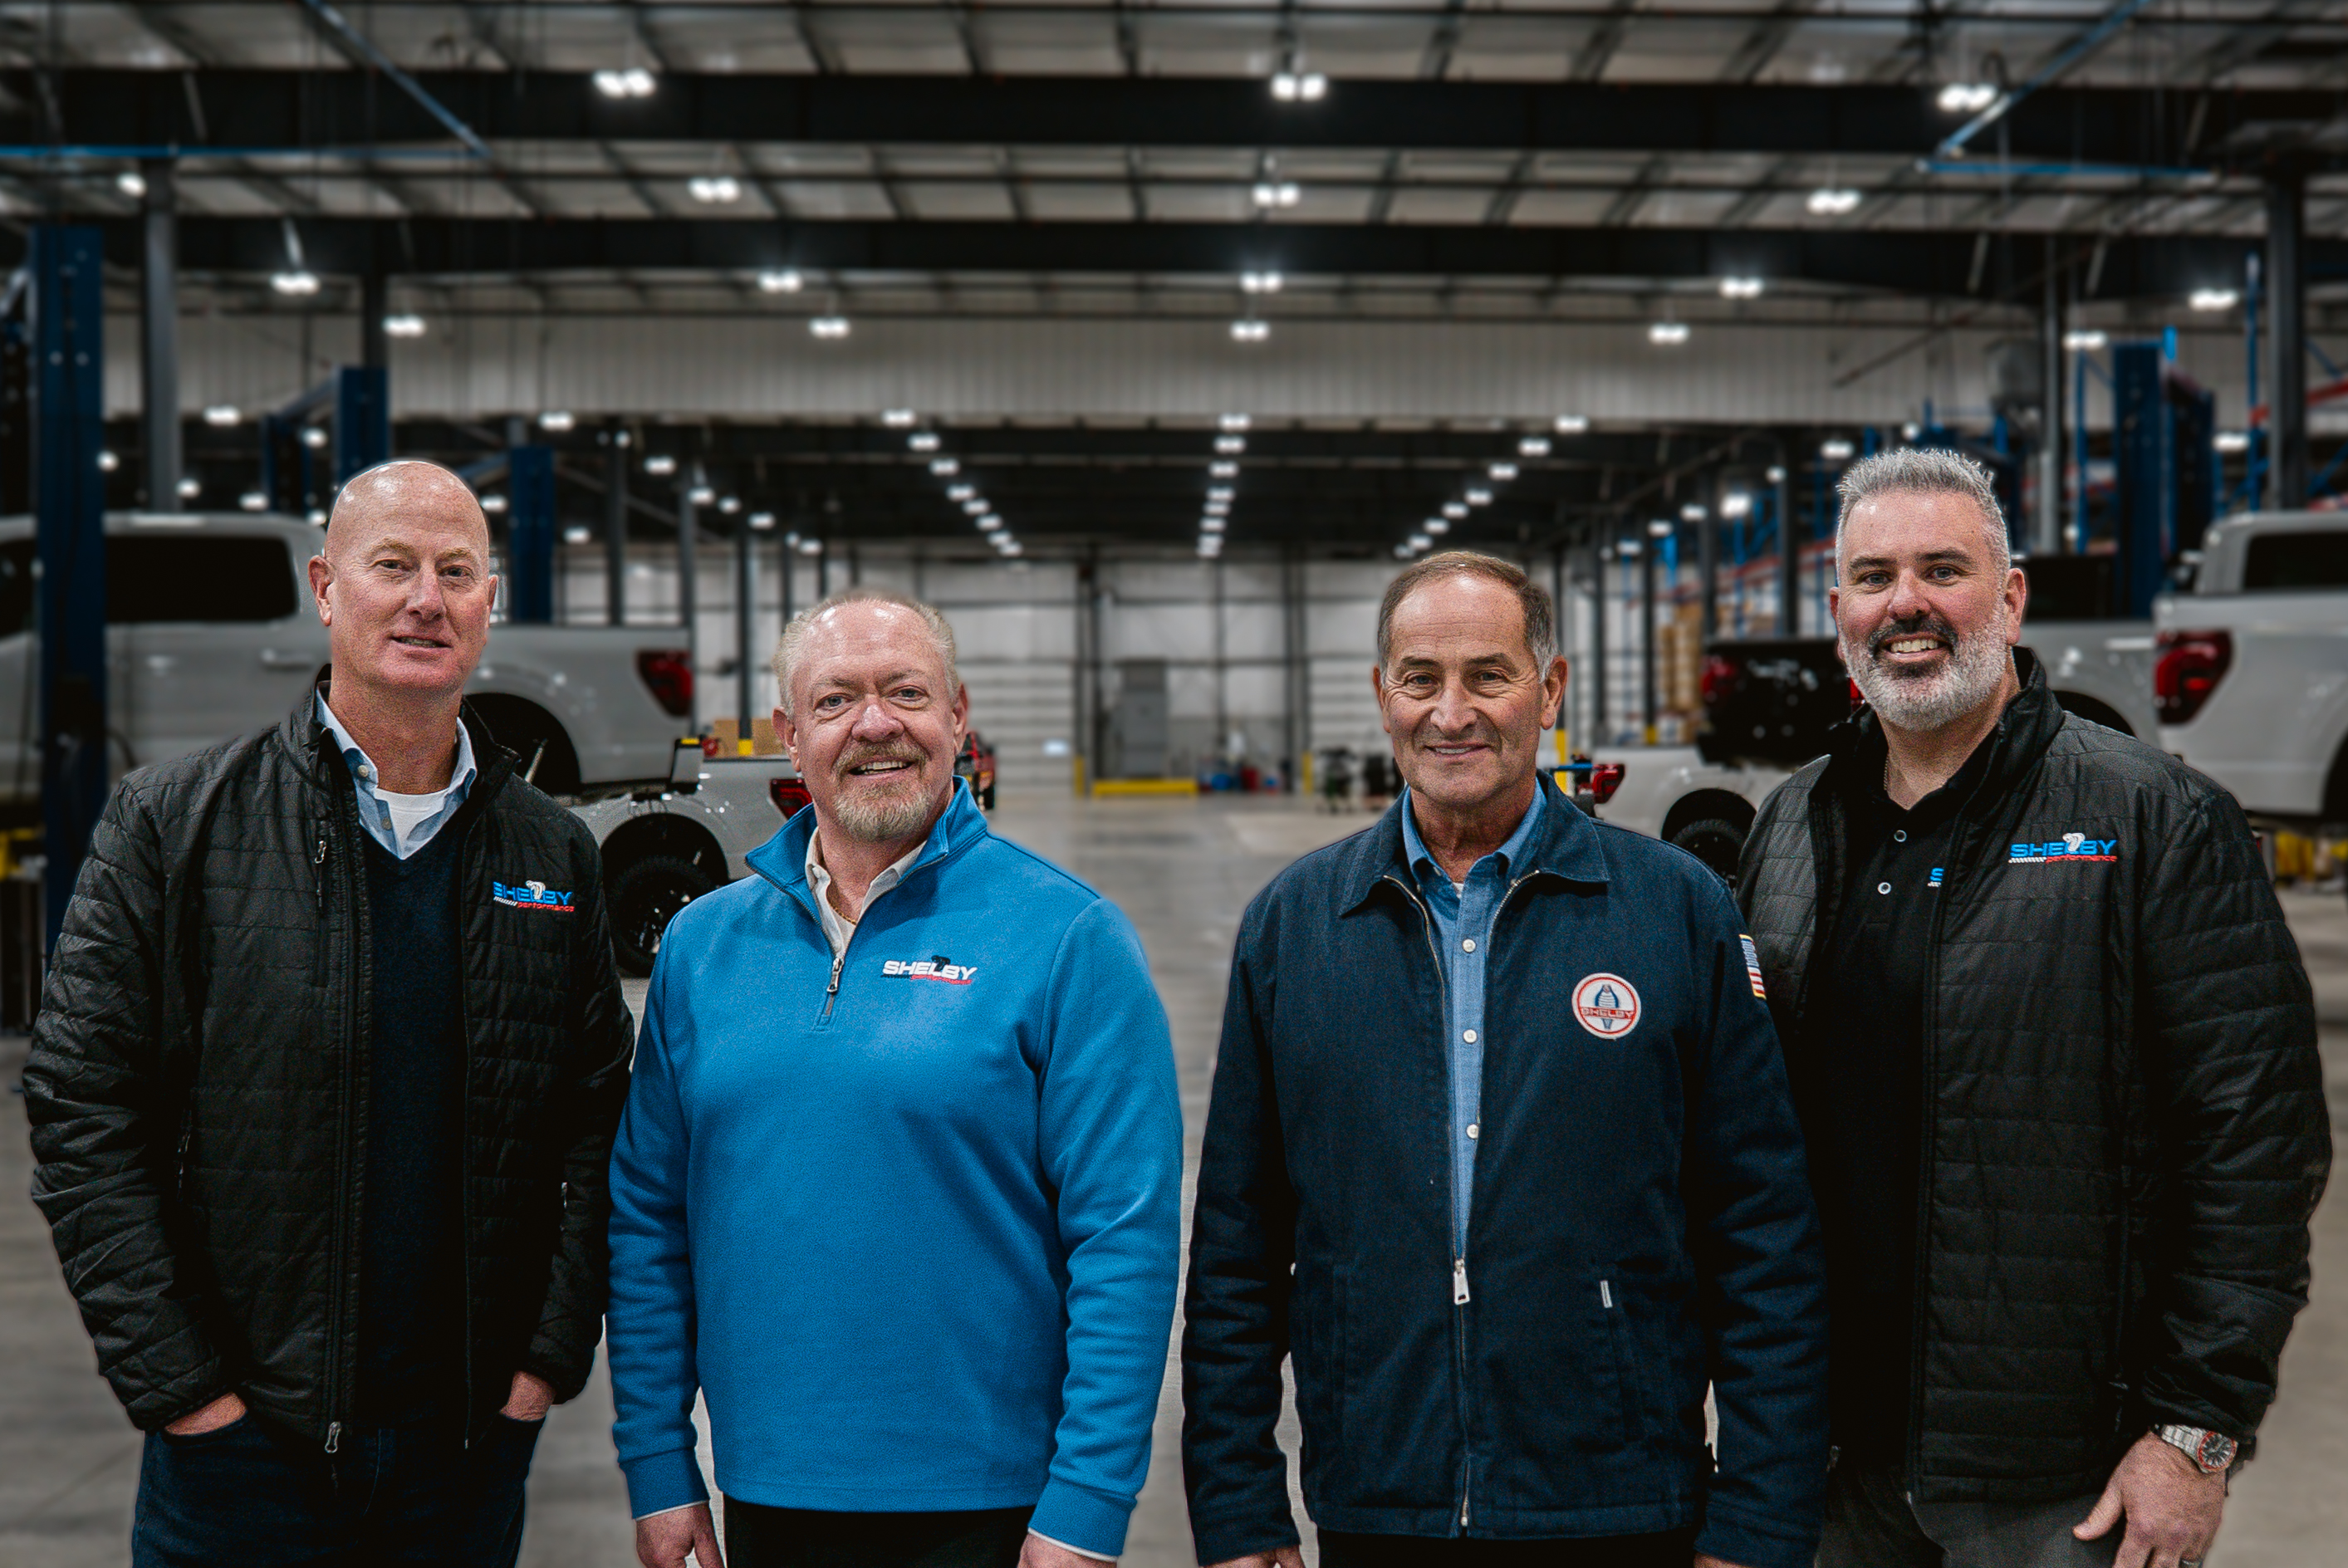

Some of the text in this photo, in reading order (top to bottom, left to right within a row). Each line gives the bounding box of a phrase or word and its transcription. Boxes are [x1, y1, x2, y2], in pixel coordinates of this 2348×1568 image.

[2010, 840, 2117, 857] SHELBY
[493, 881, 572, 905] SHELBY
[517, 901, 575, 912] performance
[882, 960, 978, 980] SHELBY
[1582, 1007, 1634, 1020] SHELBY
